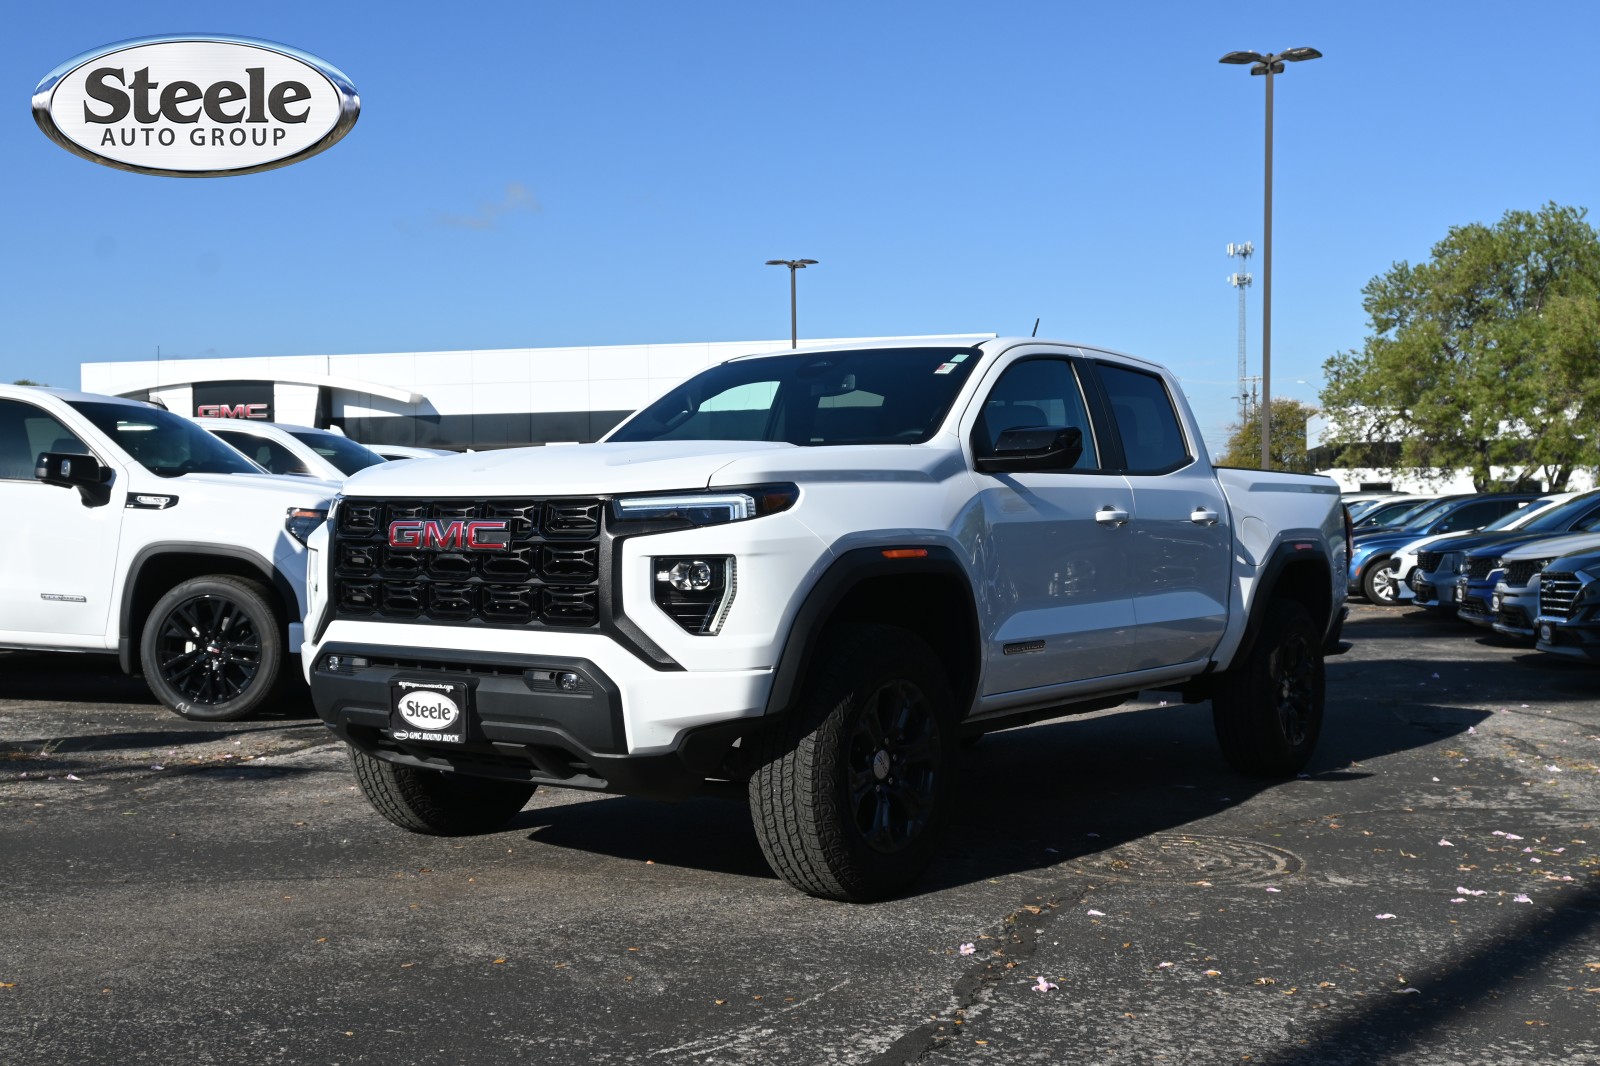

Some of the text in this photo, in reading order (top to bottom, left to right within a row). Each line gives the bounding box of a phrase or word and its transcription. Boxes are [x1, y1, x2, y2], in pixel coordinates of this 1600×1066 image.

[197, 403, 268, 419] GMC
[388, 520, 507, 550] GMC
[406, 701, 451, 720] Steele
